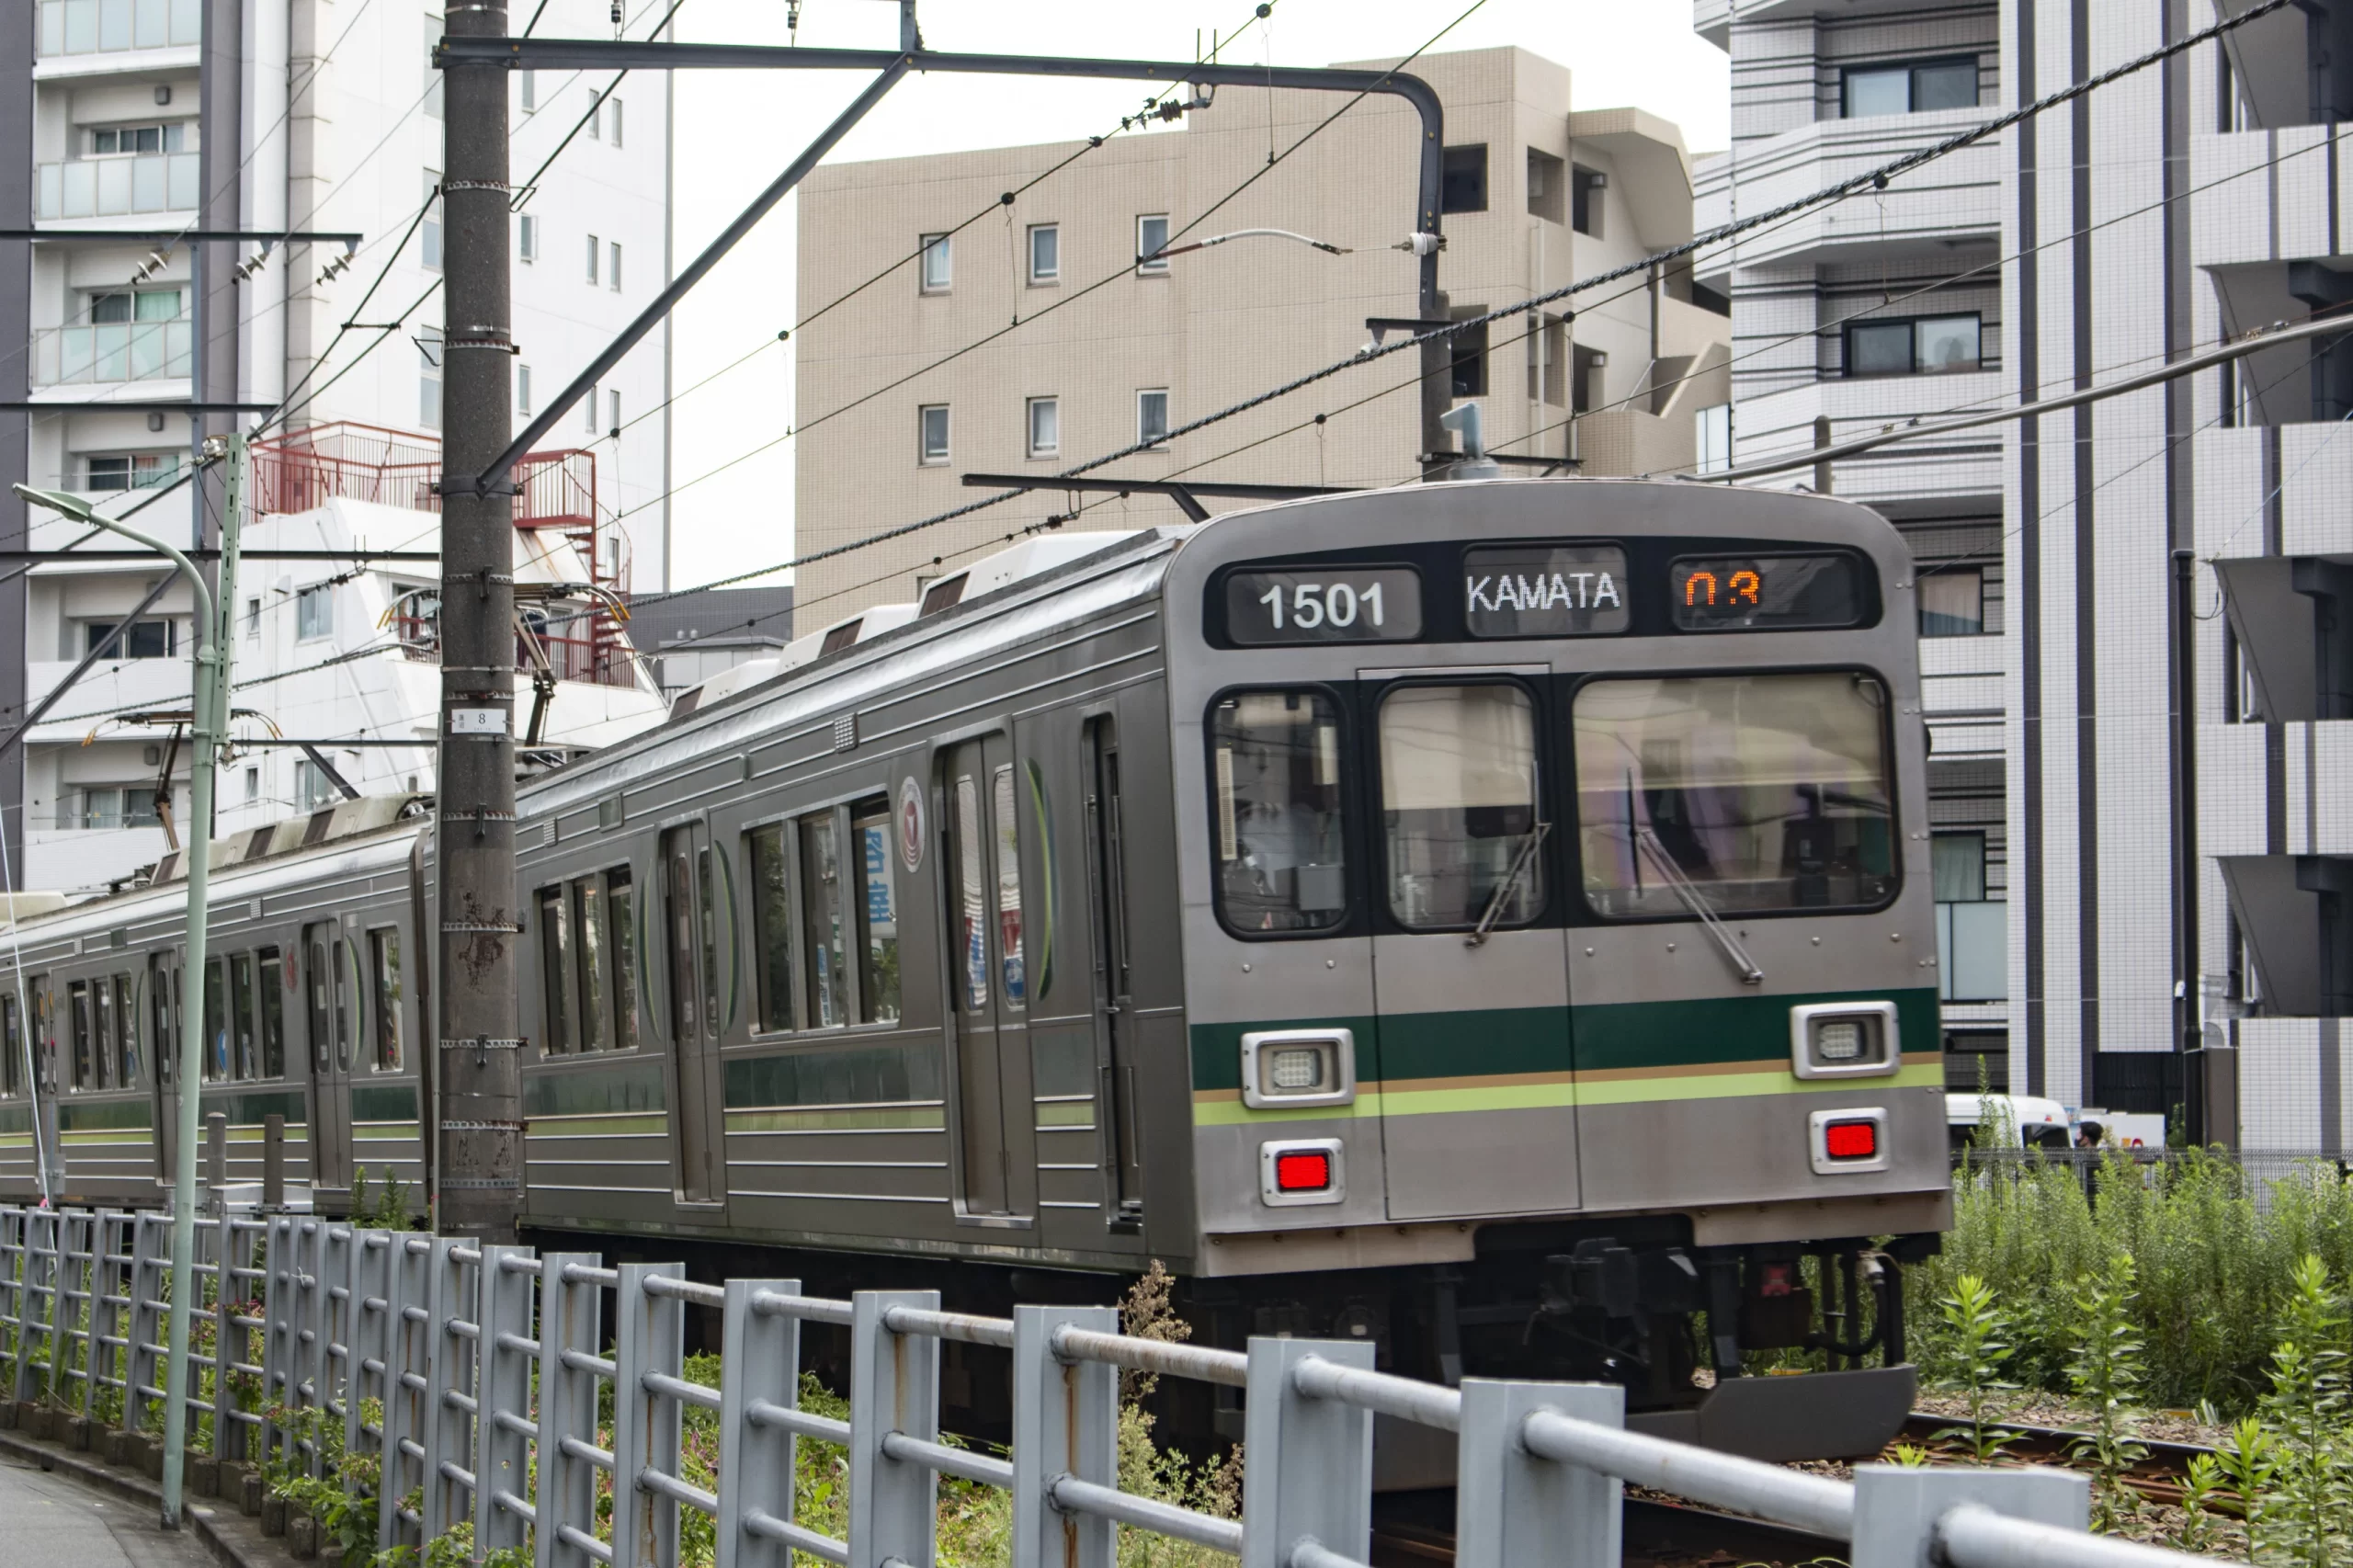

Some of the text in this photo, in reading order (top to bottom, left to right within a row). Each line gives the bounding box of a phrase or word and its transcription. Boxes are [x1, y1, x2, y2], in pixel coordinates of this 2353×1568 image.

[1260, 582, 1385, 630] 1501
[1467, 572, 1622, 613] KAMATA
[478, 713, 486, 724] 8
